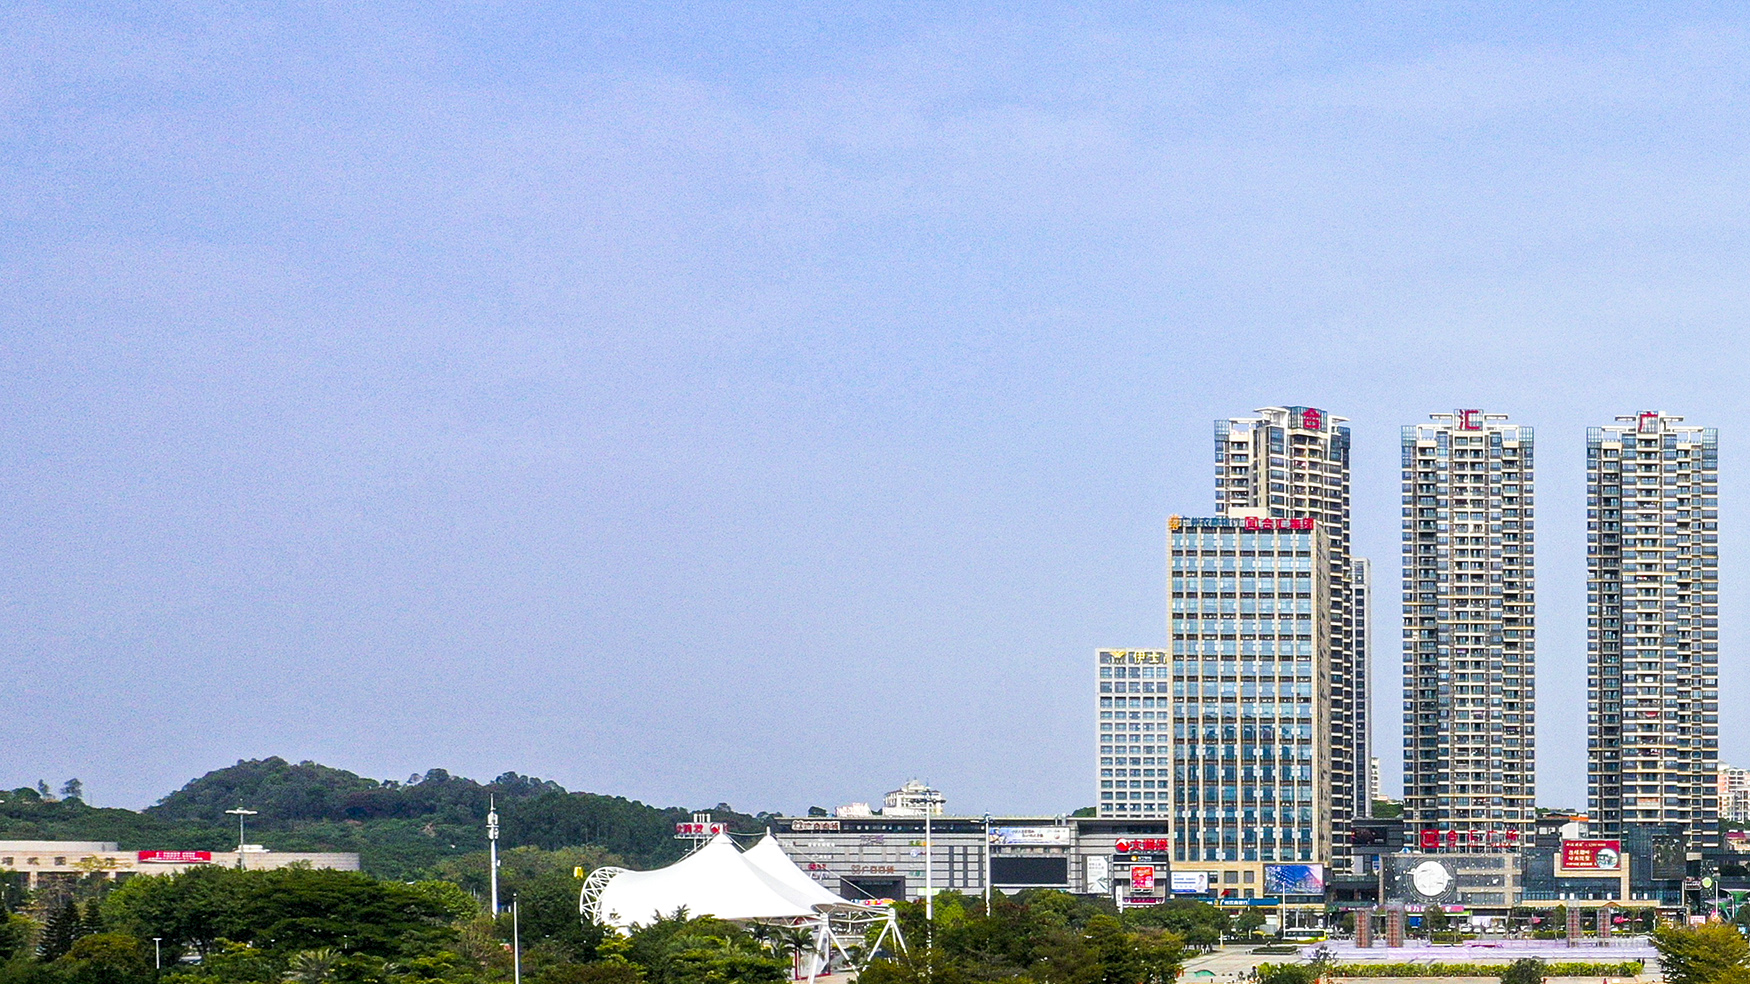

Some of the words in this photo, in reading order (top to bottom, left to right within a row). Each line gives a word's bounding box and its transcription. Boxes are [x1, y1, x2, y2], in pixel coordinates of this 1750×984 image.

[1302, 407, 1321, 429] 合
[1459, 409, 1481, 430] 汇
[1638, 411, 1659, 432] 广
[1134, 651, 1168, 665] 伊士
